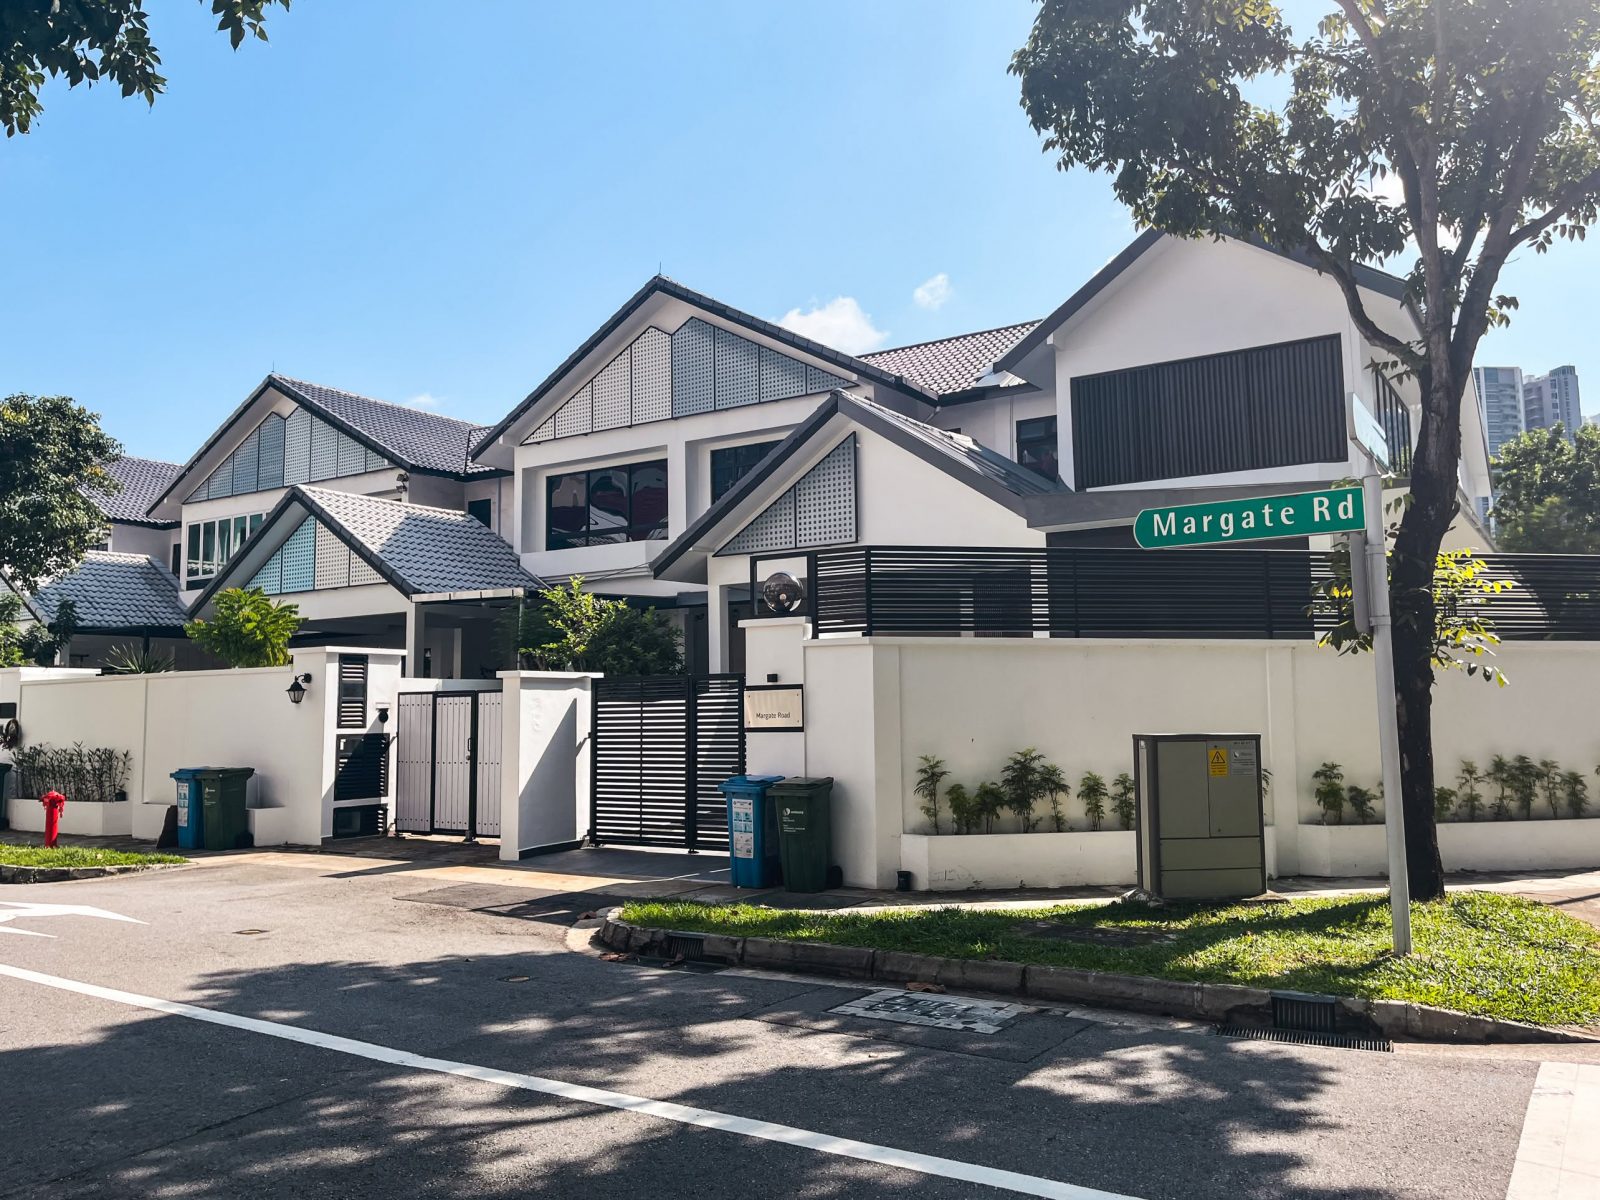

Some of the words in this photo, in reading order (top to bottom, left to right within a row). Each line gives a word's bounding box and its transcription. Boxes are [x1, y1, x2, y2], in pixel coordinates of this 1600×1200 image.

[1153, 503, 1295, 537] Margate
[1313, 493, 1354, 522] Rd
[756, 712, 777, 721] Margate
[778, 711, 791, 719] Road
